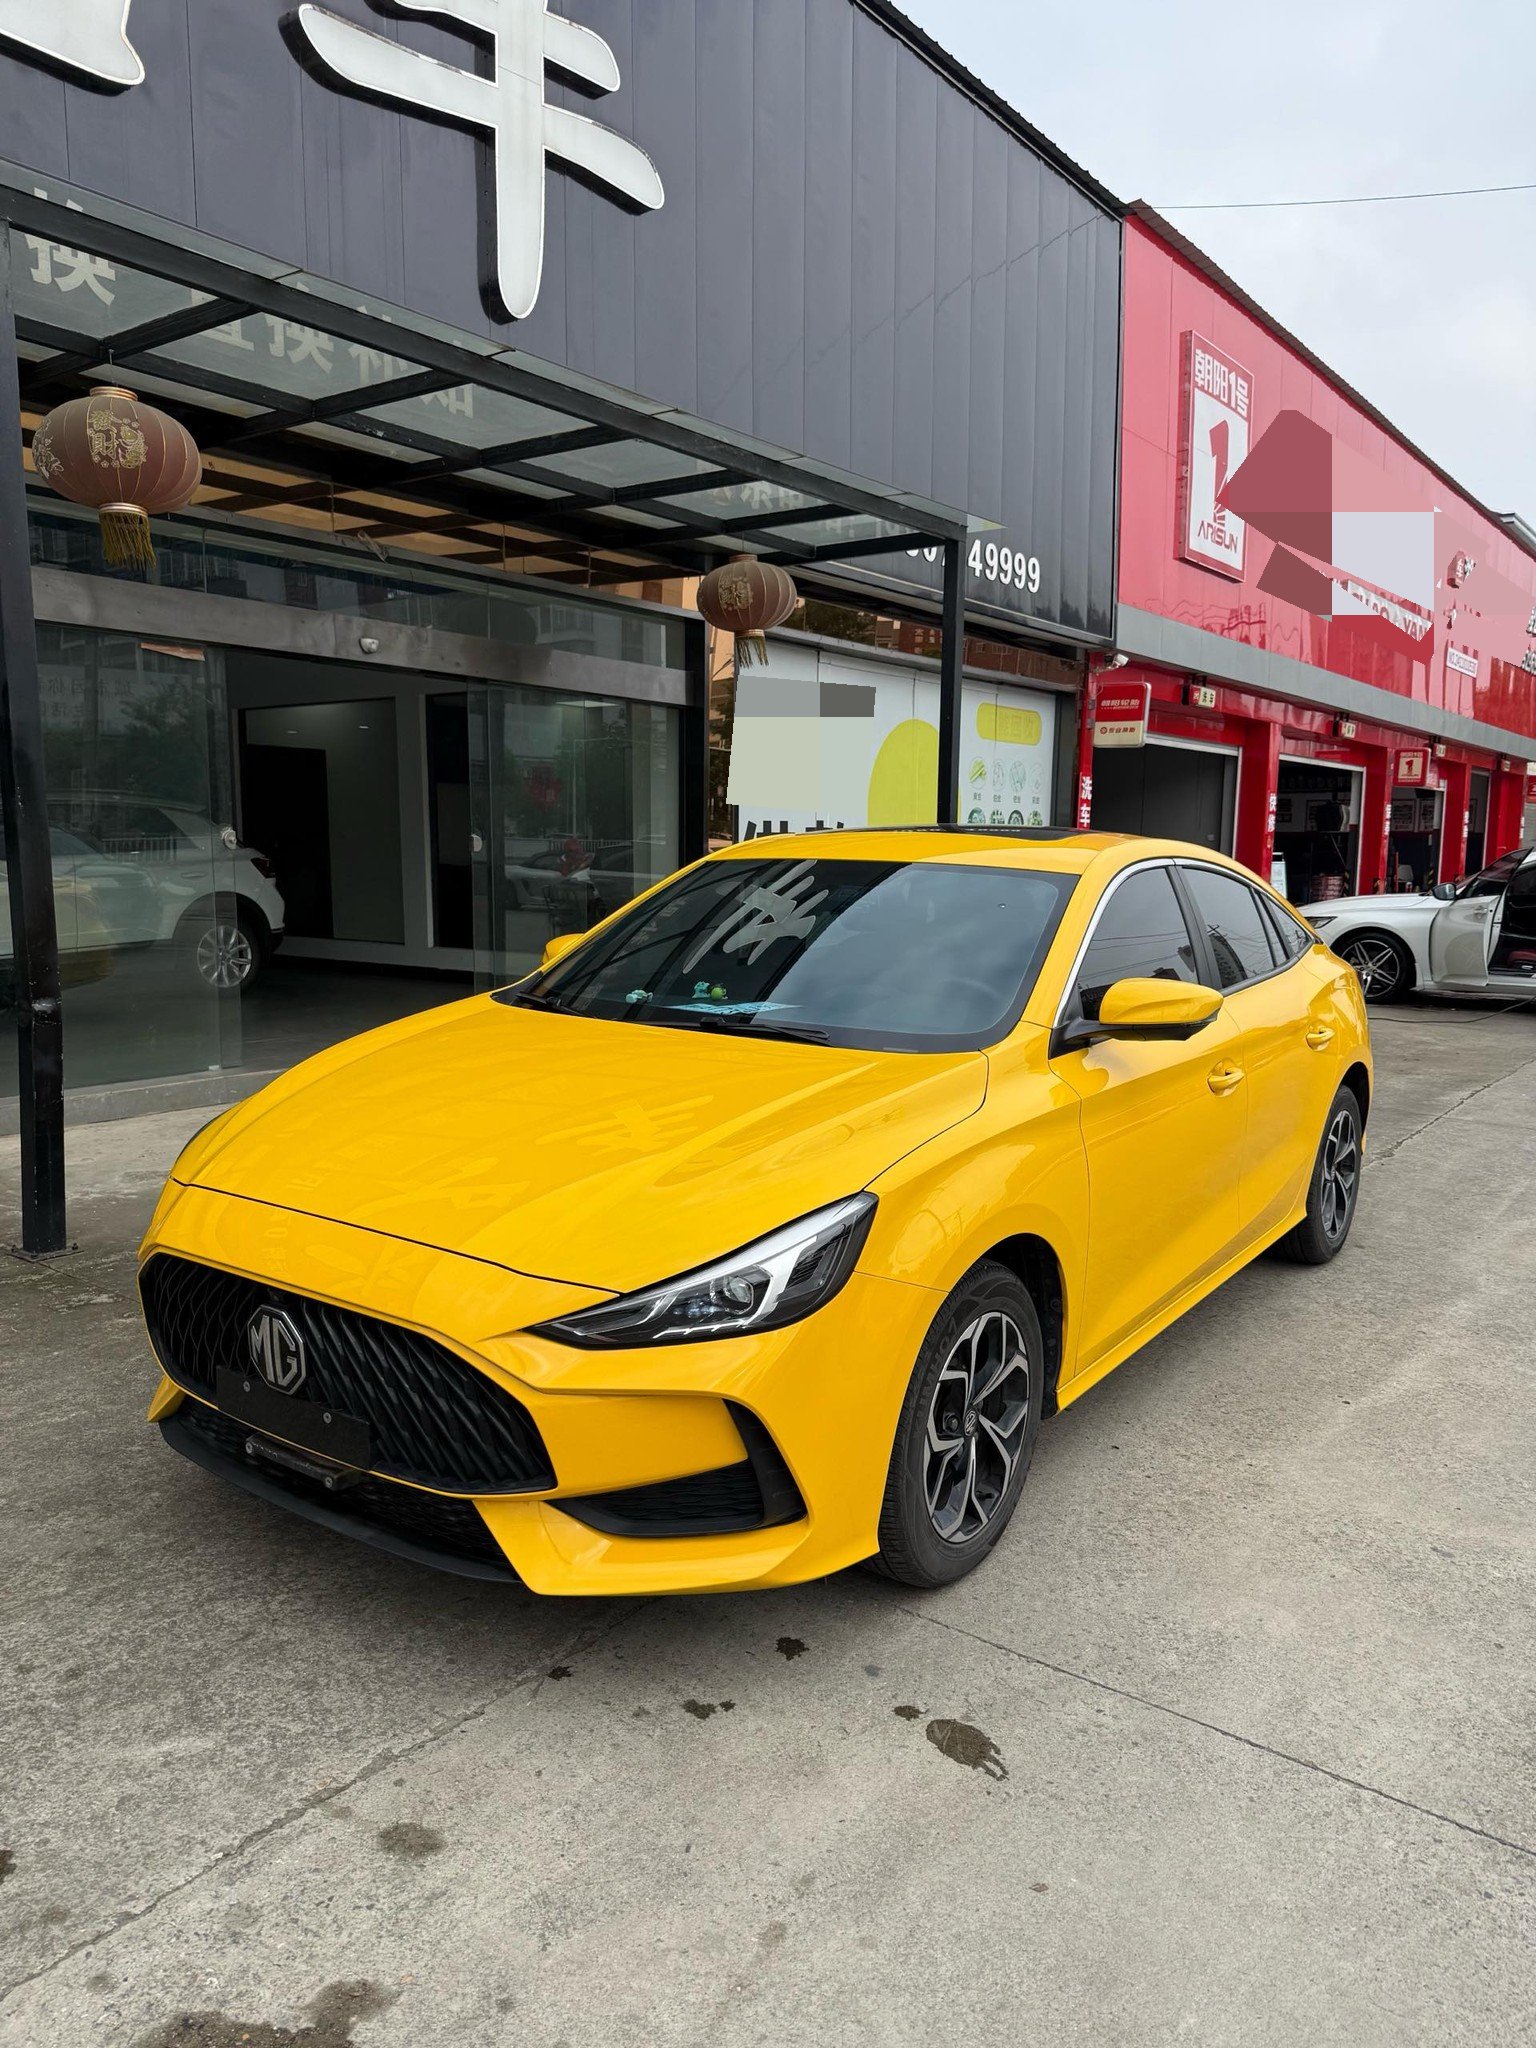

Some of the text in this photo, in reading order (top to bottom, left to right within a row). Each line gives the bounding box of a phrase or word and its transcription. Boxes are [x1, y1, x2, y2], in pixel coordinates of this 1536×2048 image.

[1194, 349, 1249, 418] 朝阳1号
[1197, 519, 1239, 554] ARISUN
[251, 1314, 299, 1388] MG
